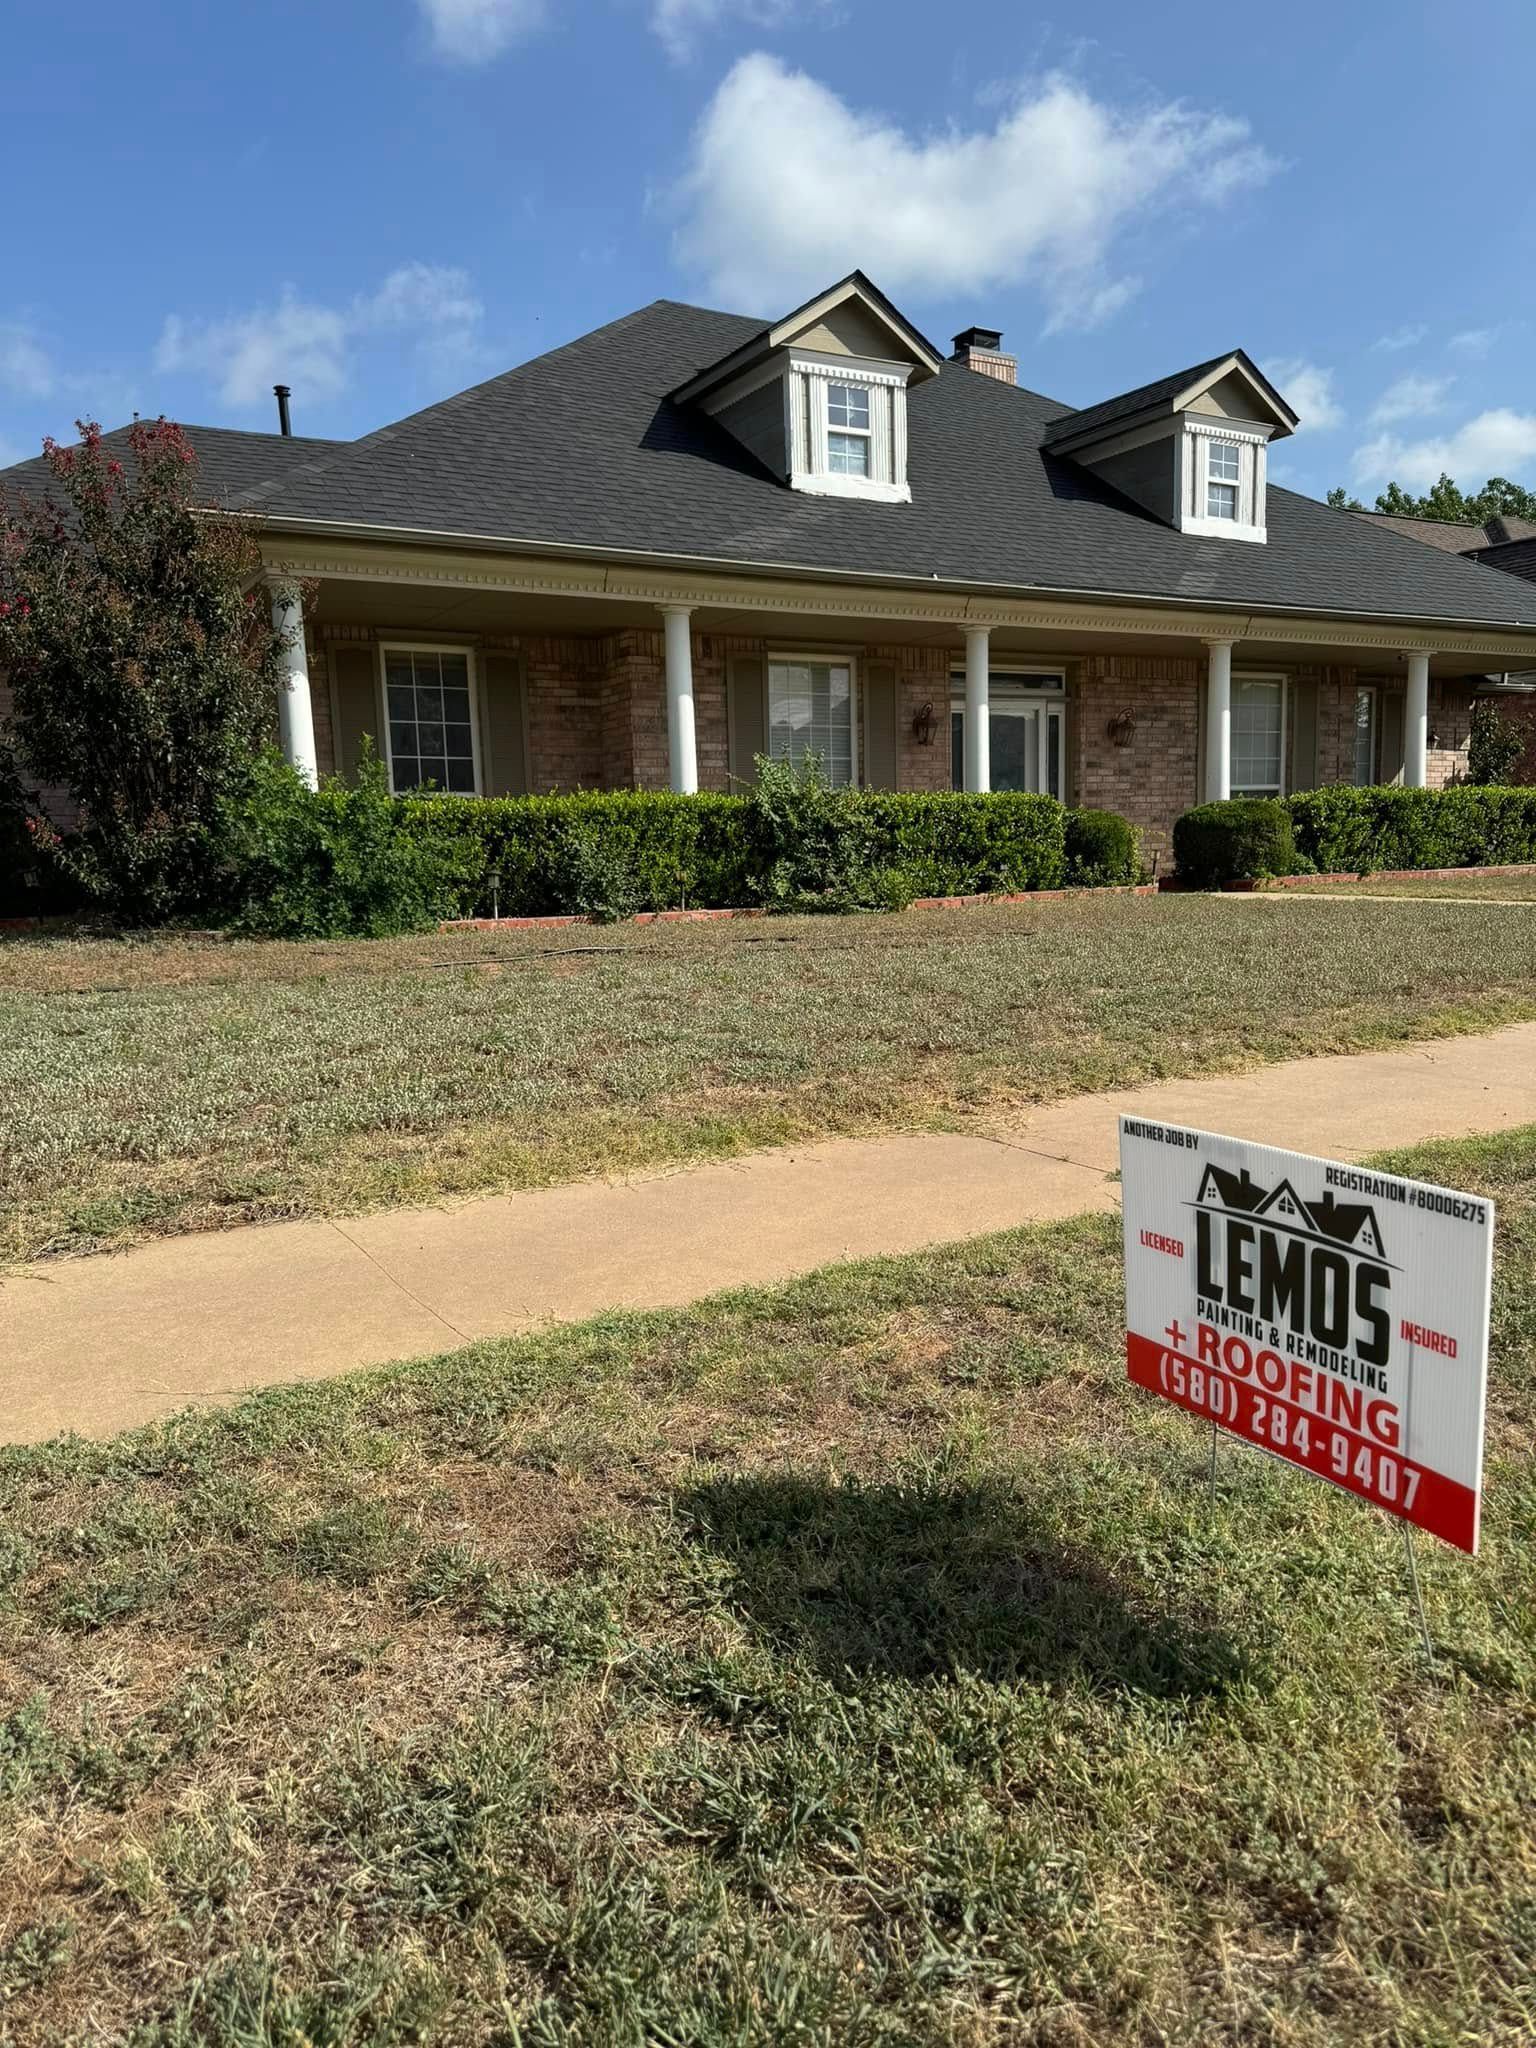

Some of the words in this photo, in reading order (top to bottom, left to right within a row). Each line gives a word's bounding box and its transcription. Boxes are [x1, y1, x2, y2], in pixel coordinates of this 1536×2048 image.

[1124, 1120, 1164, 1142] ANOTHER
[1165, 1129, 1184, 1148] JOB
[1186, 1134, 1199, 1151] BY
[1325, 1167, 1406, 1204] REGISTRATION
[1408, 1186, 1485, 1225] #80006275
[1140, 1229, 1184, 1258] LICENSED
[1196, 1210, 1391, 1367] LEMOS
[1197, 1299, 1263, 1342] PAINTING
[1269, 1328, 1280, 1348] &
[1286, 1334, 1388, 1394] REMODELING
[1401, 1320, 1457, 1359] INSURED
[1165, 1319, 1187, 1349] +
[1198, 1323, 1400, 1448] ROOFING
[1160, 1352, 1239, 1420] (580)
[1252, 1395, 1421, 1510] 284-9407
